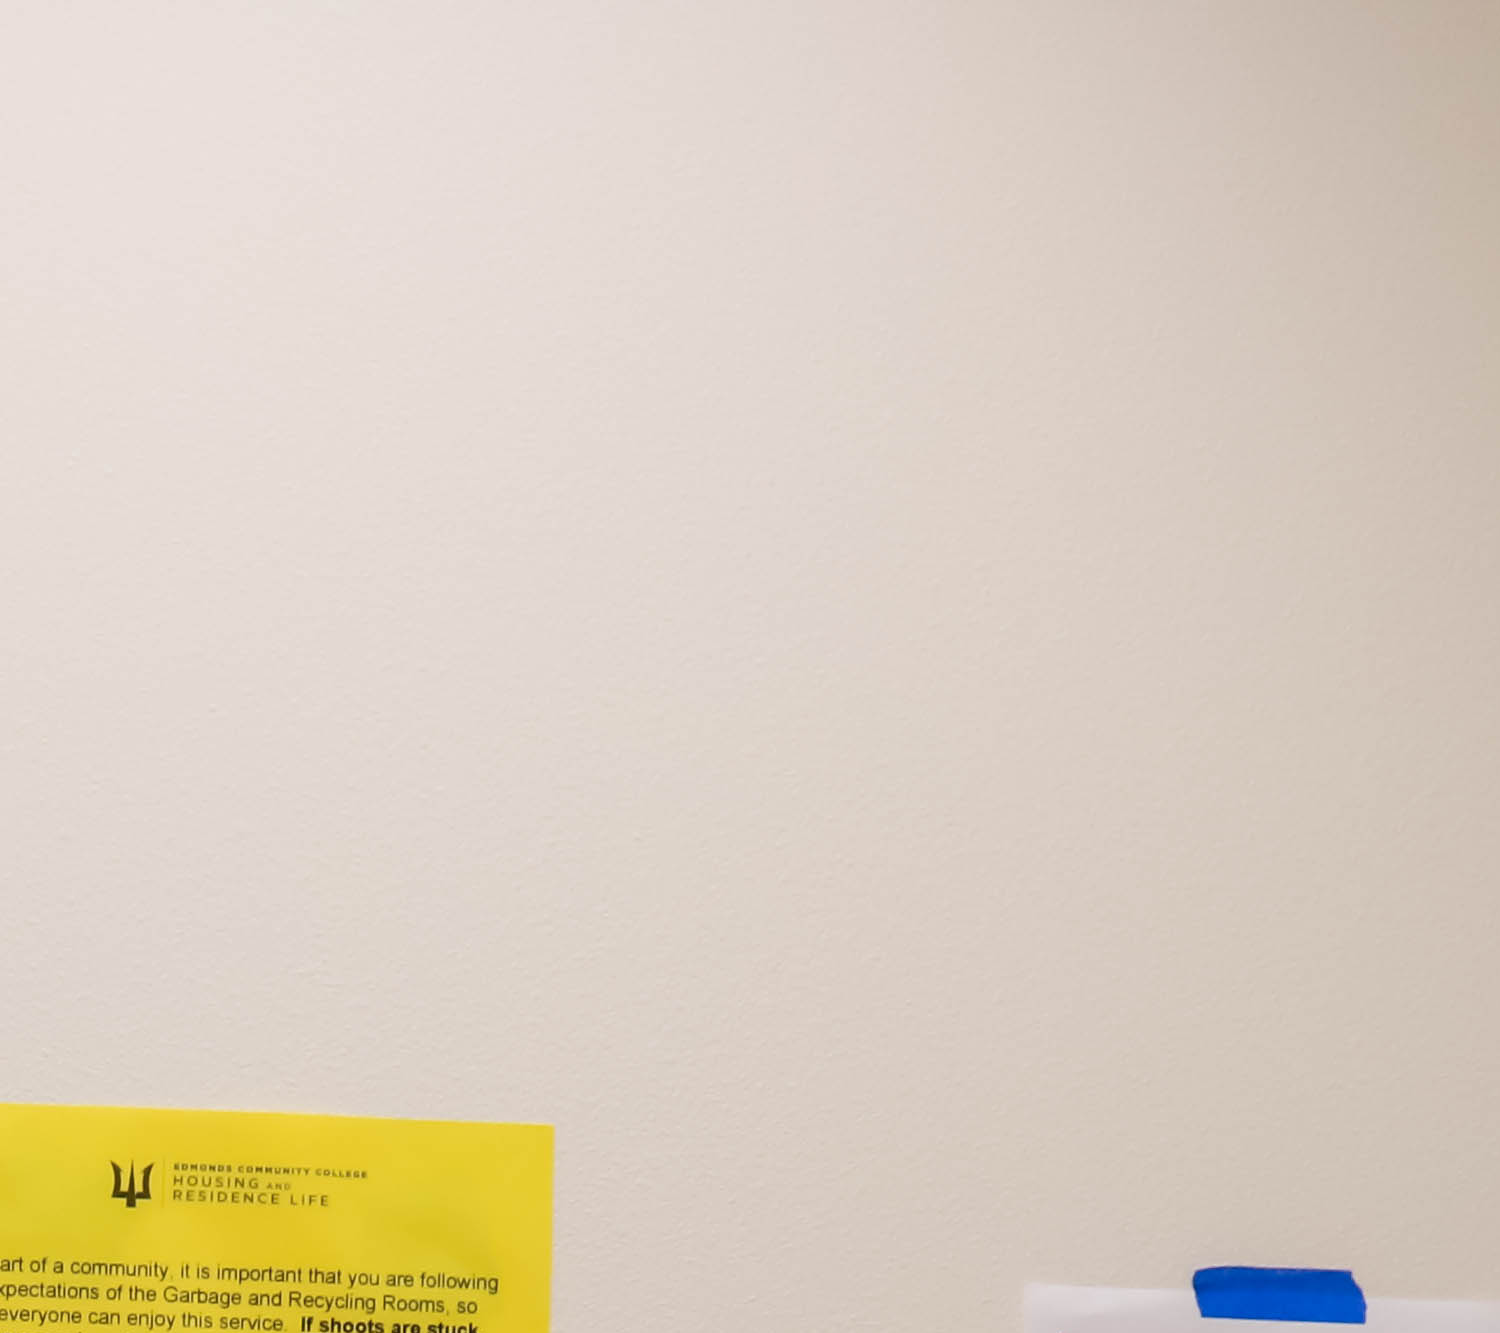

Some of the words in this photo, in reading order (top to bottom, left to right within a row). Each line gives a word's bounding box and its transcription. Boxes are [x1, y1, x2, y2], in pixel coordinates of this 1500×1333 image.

[172, 1162, 232, 1173] EDMONDS
[236, 1164, 309, 1176] COMMUNITY
[314, 1168, 367, 1179] COLLEGE
[172, 1174, 259, 1190] HOUSING
[265, 1182, 290, 1190] AND
[171, 1188, 280, 1205] RESIDENCE
[289, 1193, 328, 1207] LIFE
[104, 1283, 123, 1301] of
[127, 1284, 157, 1302] the
[162, 1284, 242, 1310] Garbage
[247, 1289, 282, 1307] and
[287, 1289, 376, 1315] Recycling
[381, 1293, 449, 1316] Rooms,
[456, 1299, 478, 1315] so
